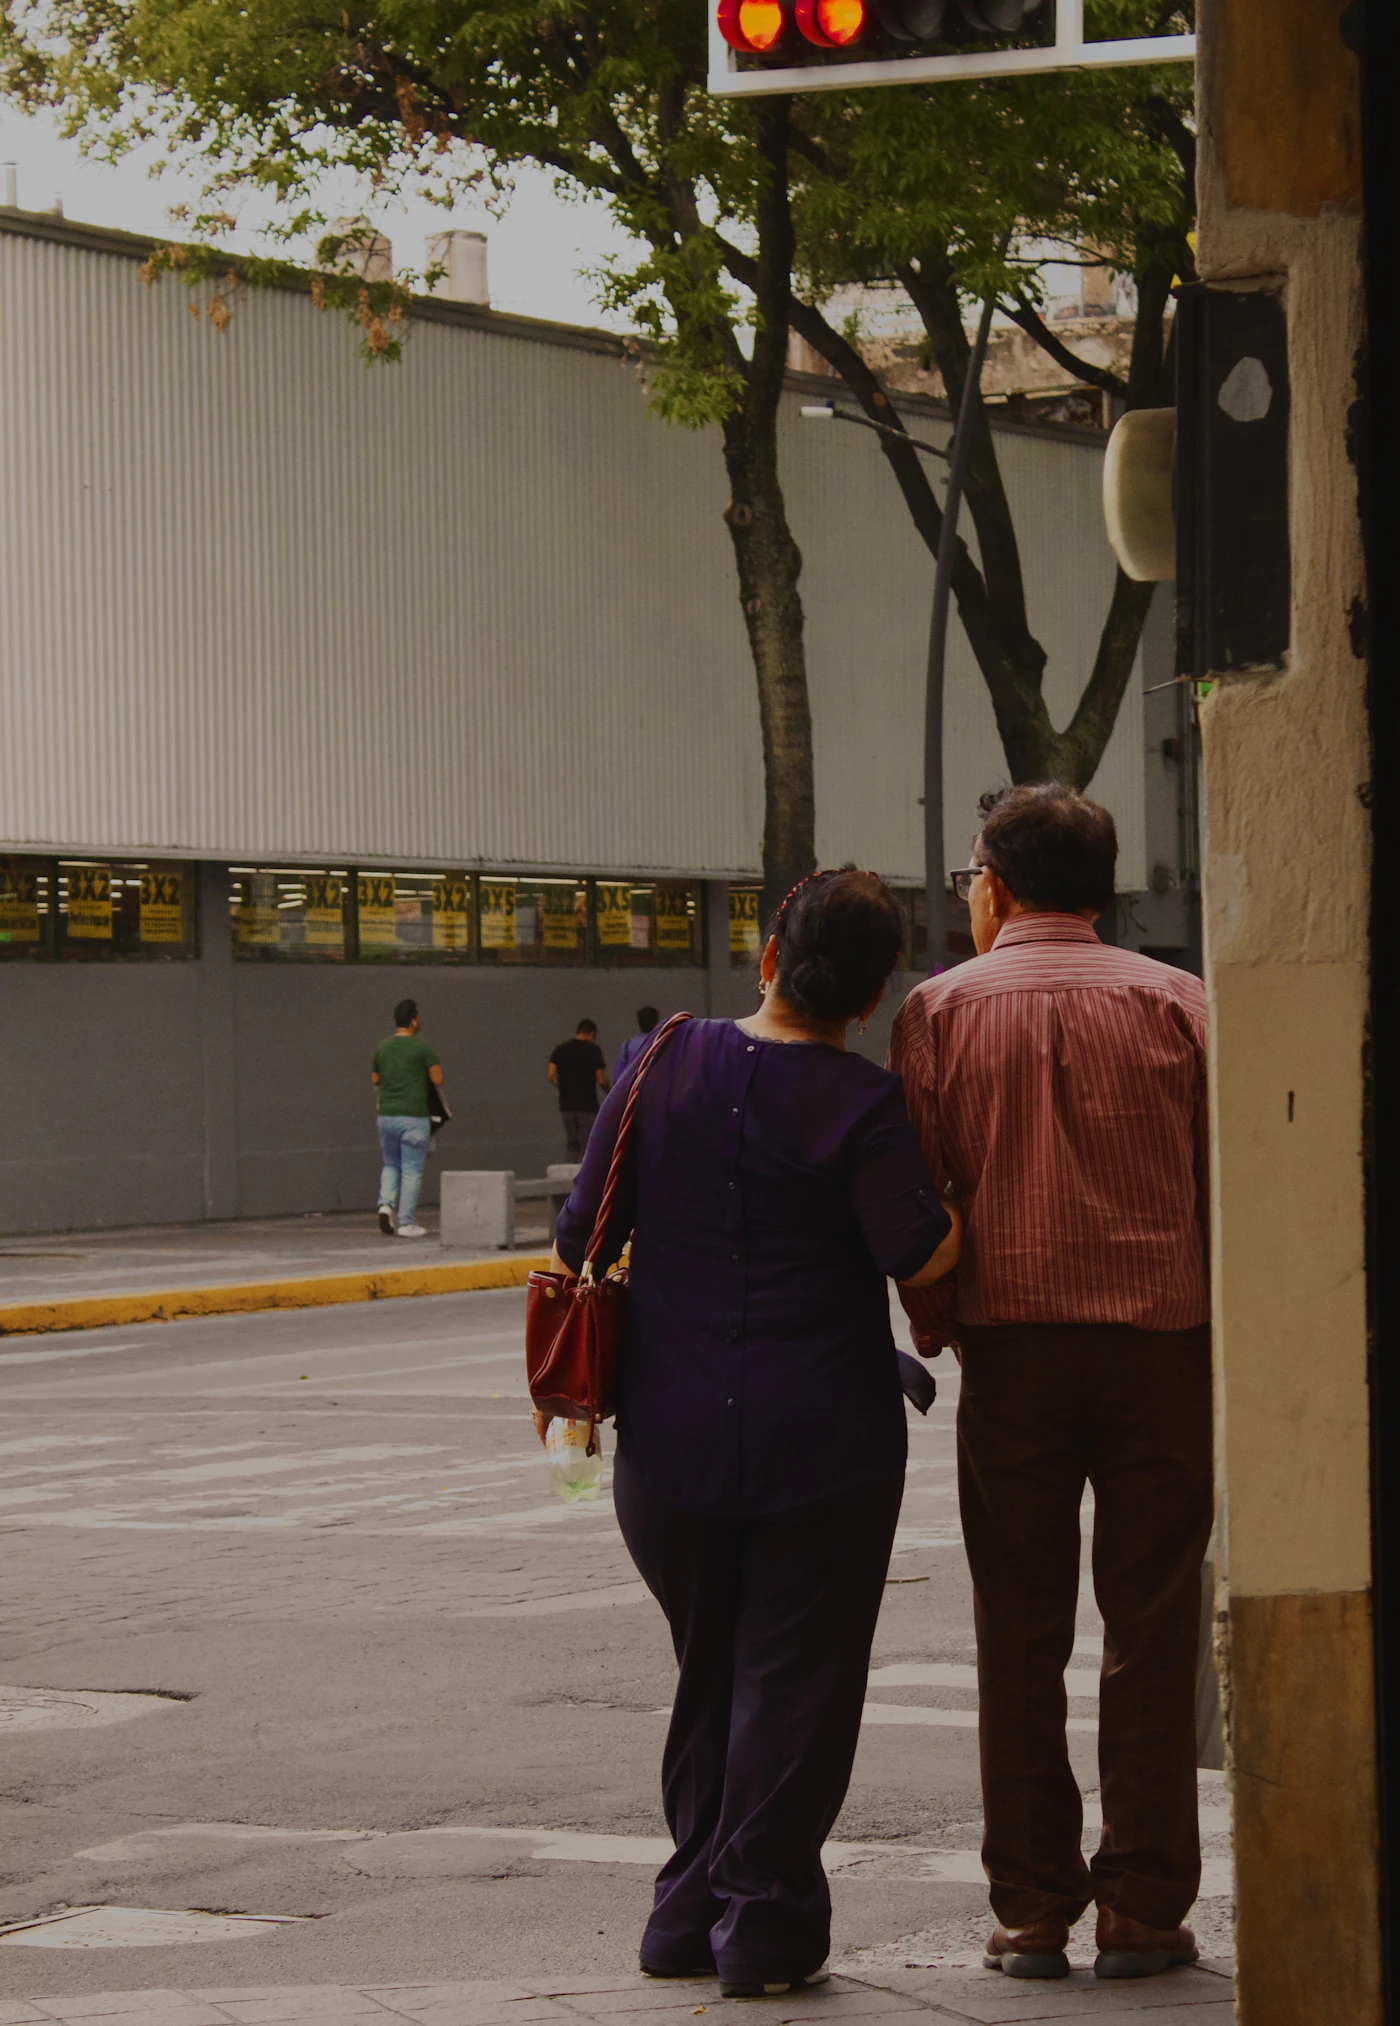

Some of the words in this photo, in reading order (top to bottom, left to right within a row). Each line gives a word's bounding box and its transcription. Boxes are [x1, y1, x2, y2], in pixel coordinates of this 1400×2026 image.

[69, 871, 110, 901] 3X2
[141, 876, 180, 905] 3X2
[358, 880, 394, 907] 3X2
[433, 885, 467, 911] 3X2
